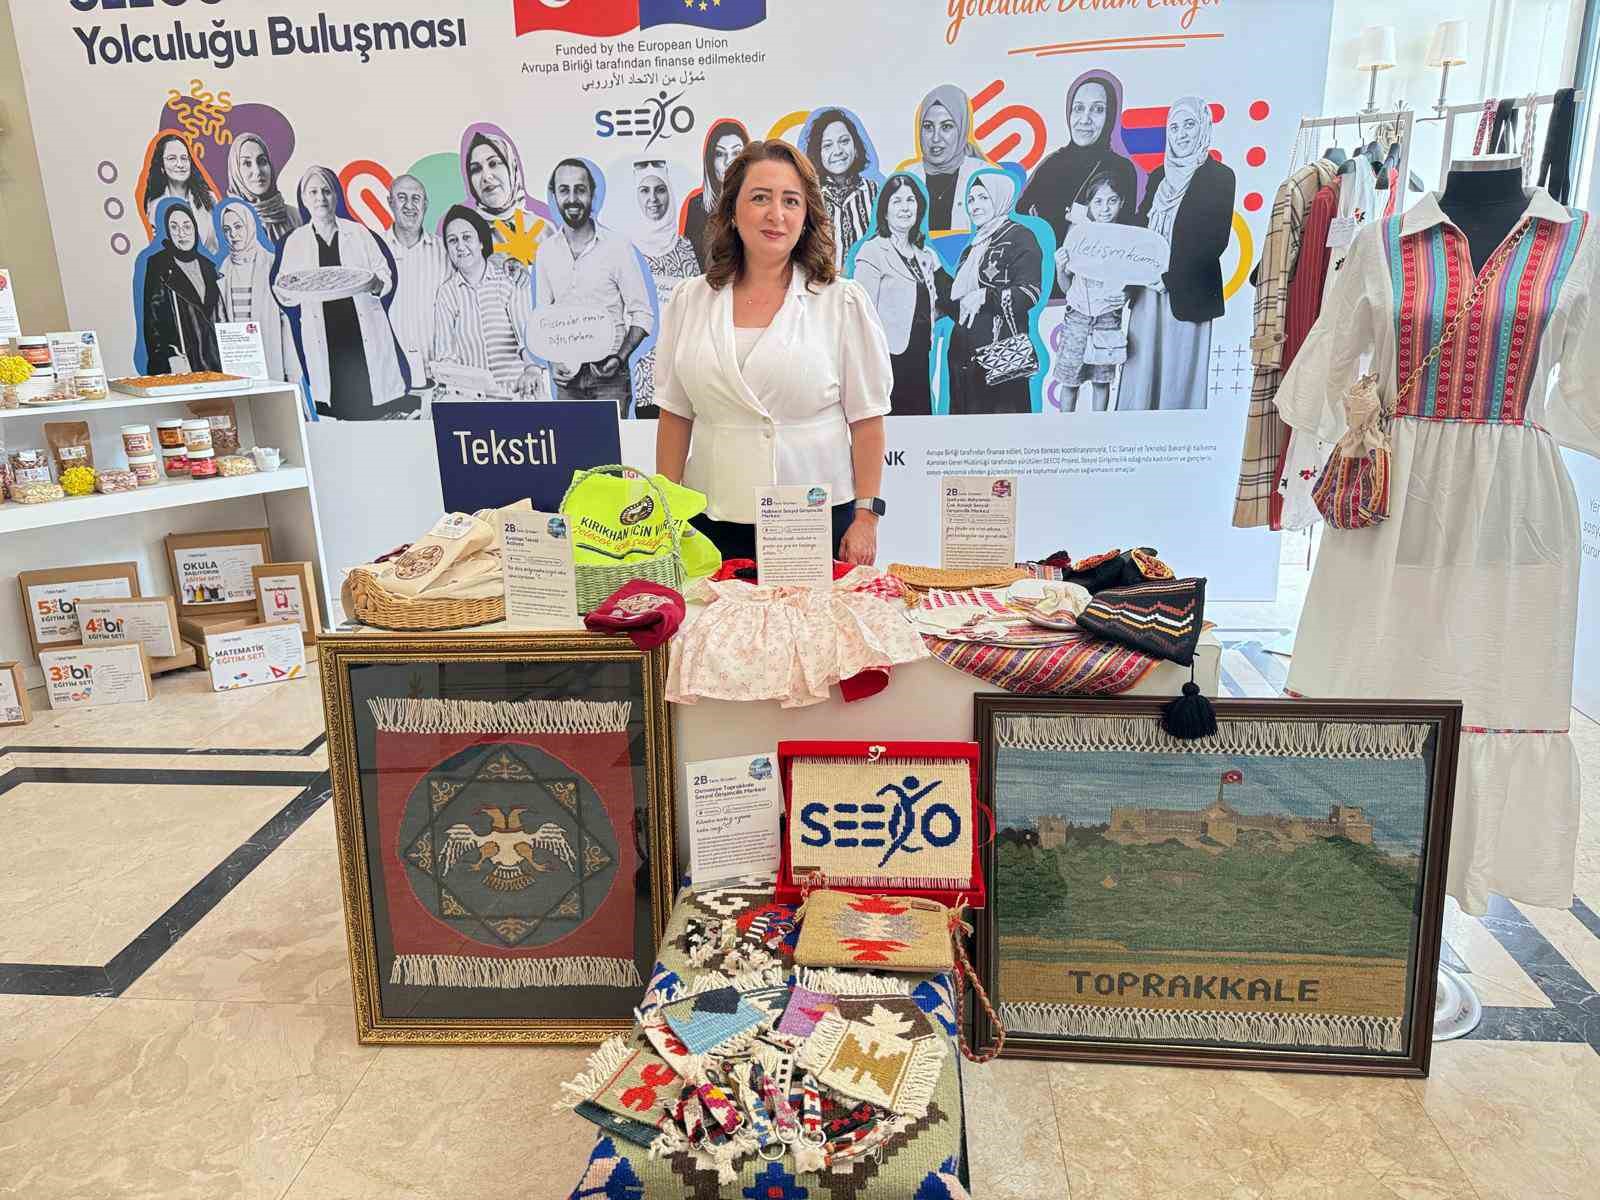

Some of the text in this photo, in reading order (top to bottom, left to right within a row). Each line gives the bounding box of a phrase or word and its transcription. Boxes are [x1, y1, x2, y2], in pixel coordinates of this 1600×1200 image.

[72, 12, 467, 69] Yolculuğu Buluşması
[555, 38, 729, 56] Funded by the European Union
[521, 52, 767, 75] Avrupa Birliği tarafından finanse edilmektedir
[452, 429, 558, 465] Tekstil
[884, 451, 906, 466] NK
[760, 497, 773, 506] 2B
[580, 516, 628, 541] KIRIKHAN
[183, 561, 218, 571] OKULA
[37, 601, 51, 615] 5
[86, 619, 97, 633] 4
[215, 644, 264, 658] MATEMATİK
[48, 667, 63, 681] 3
[693, 775, 709, 787] 2B
[1067, 970, 1320, 1002] TOPRAKKALE
